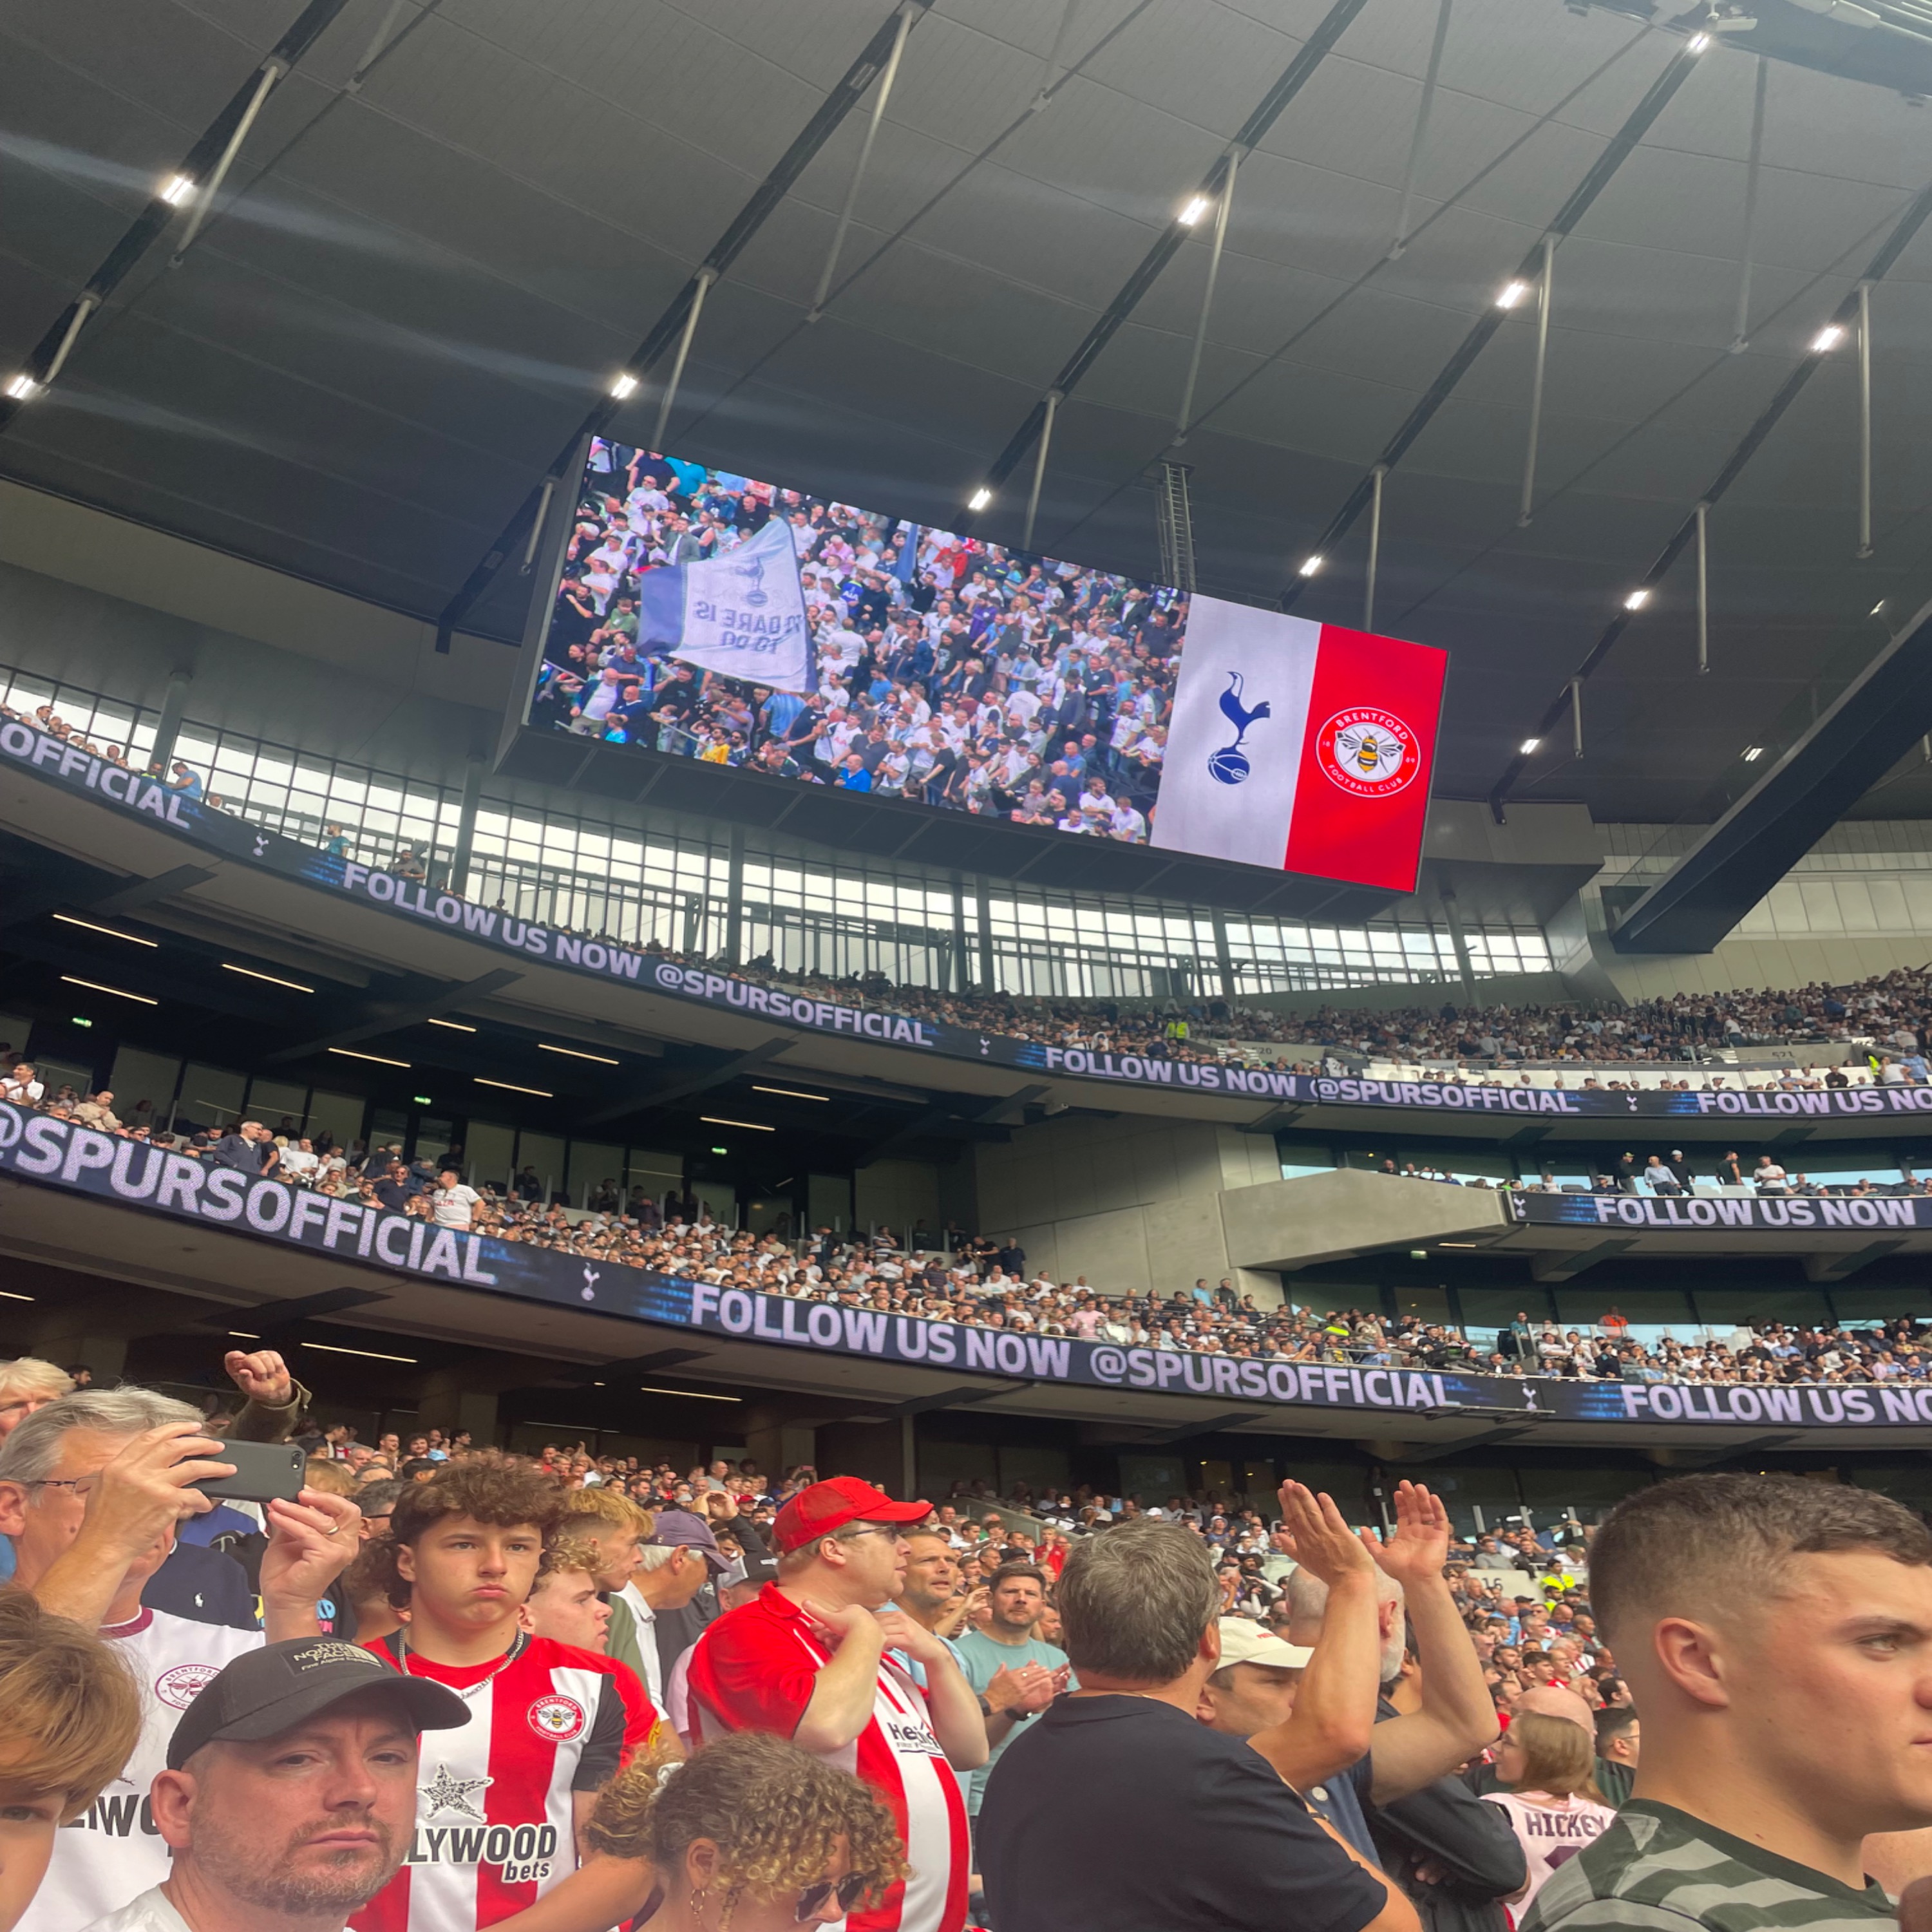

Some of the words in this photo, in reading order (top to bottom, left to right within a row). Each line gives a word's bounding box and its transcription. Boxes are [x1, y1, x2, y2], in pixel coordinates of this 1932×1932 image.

[1335, 712, 1408, 740] BRENTFORD
[1328, 764, 1374, 792] FOOTBALL
[1378, 777, 1403, 791] CLUB
[343, 862, 496, 937] FOLLOW
[502, 918, 547, 954] US
[555, 936, 642, 980] NOW
[655, 963, 933, 1046] @SPURSOFFICIAL
[1045, 1047, 1173, 1082] FOLLOW
[1179, 1064, 1220, 1088] US
[1225, 1068, 1296, 1096] NOW
[1309, 1078, 1580, 1112] @SPURSOFFICIAL
[1696, 1092, 1831, 1115] FOLLOW
[1835, 1090, 1884, 1113] US
[1594, 1197, 1760, 1226] FOLLOW
[1763, 1198, 1815, 1226] US
[1814, 1199, 1917, 1226] NOW
[691, 1282, 887, 1353] FOLLOW
[896, 1318, 957, 1363] US
[966, 1332, 1070, 1378] NOW
[1090, 1346, 1461, 1408] @SPURSOFFICIAL
[1621, 1384, 1803, 1421] FOLLOW
[1806, 1388, 1875, 1423] US
[293, 1647, 349, 1662] NORTH
[313, 1650, 354, 1662] FACE
[1524, 1812, 1607, 1837] HICKEY
[504, 1861, 550, 1881] bets
